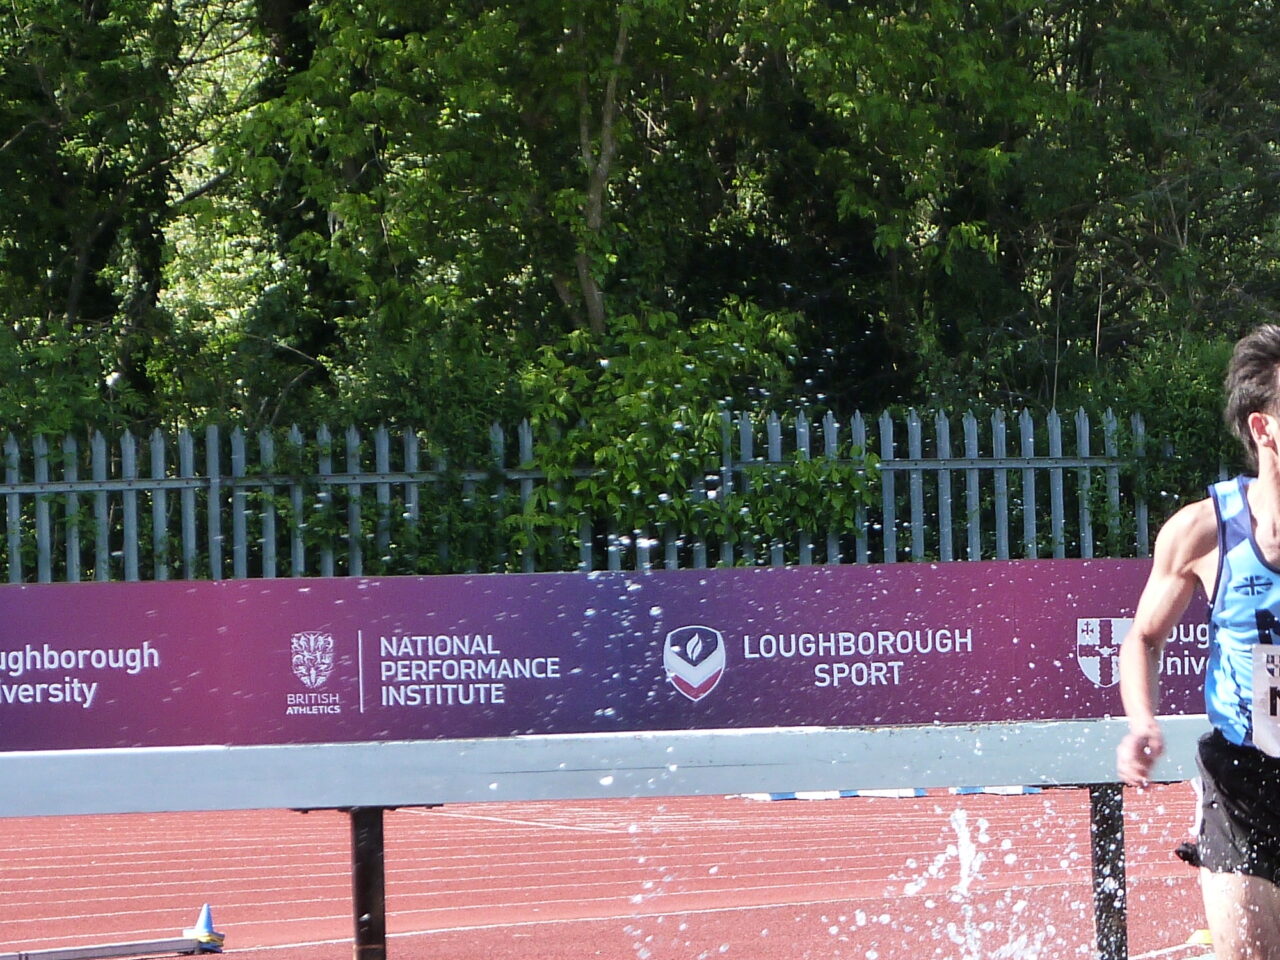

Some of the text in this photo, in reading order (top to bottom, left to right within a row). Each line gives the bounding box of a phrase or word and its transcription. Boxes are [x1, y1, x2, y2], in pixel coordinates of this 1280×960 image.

[380, 635, 500, 656] NATIONAL
[743, 629, 973, 658] LOUGHBOROUGH
[381, 658, 560, 681] PERFORMANCE
[814, 661, 904, 687] SPORT
[0, 676, 97, 708] versity
[287, 693, 339, 705] BRITISH
[381, 683, 505, 706] INSTITUTE
[286, 704, 341, 715] ATHLETICS
